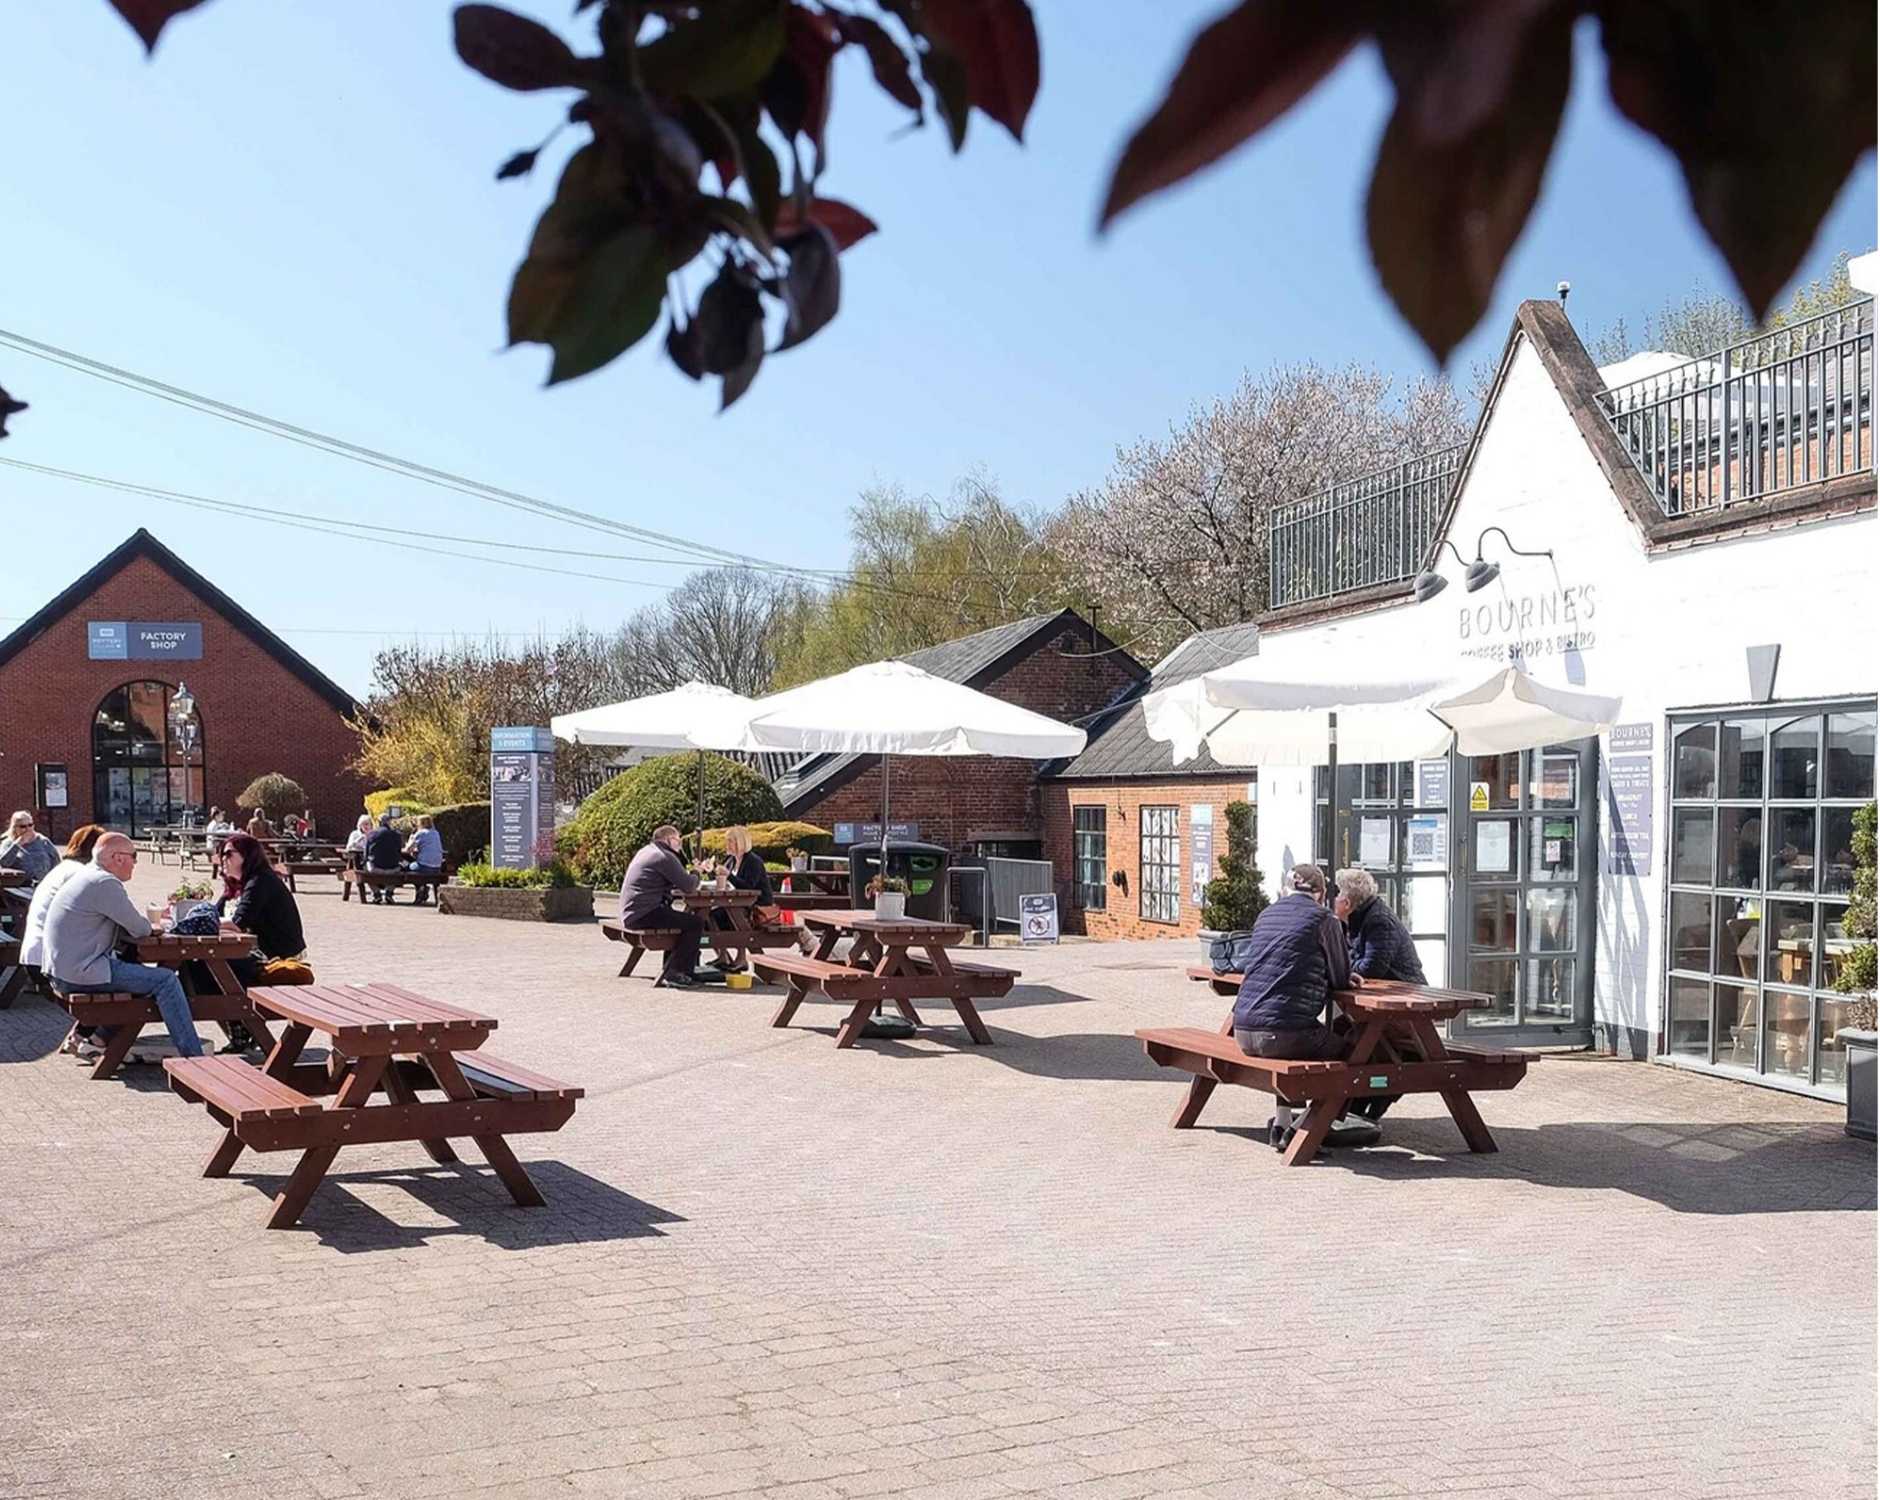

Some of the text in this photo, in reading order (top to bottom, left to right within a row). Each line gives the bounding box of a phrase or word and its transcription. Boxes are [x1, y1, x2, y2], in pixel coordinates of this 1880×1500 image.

[1459, 584, 1597, 640] BOURNE'S
[140, 631, 187, 641] FACTORY
[150, 641, 178, 649] SHOP
[1508, 639, 1543, 660] SHOP
